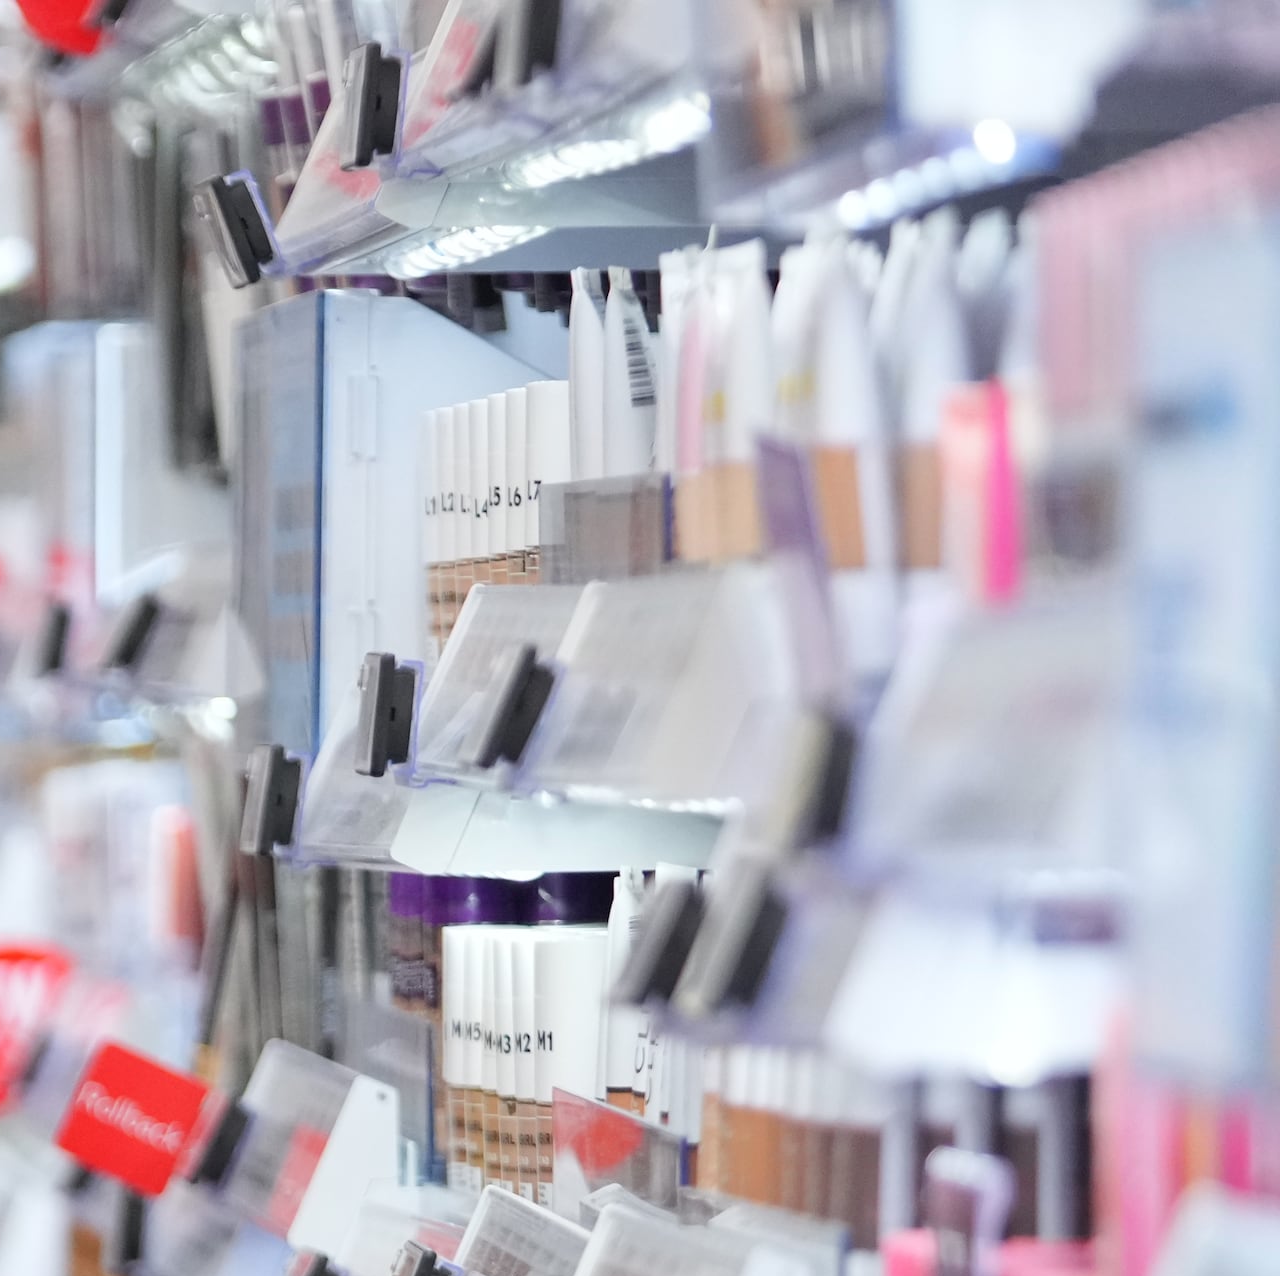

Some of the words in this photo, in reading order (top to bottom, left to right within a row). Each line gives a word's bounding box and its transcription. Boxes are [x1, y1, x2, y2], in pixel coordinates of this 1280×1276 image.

[488, 485, 501, 506] L5
[507, 486, 522, 507] L6
[526, 479, 541, 500] L7
[514, 1031, 532, 1053] M2
[536, 1029, 553, 1052] M1
[76, 1080, 185, 1155] Rollback
